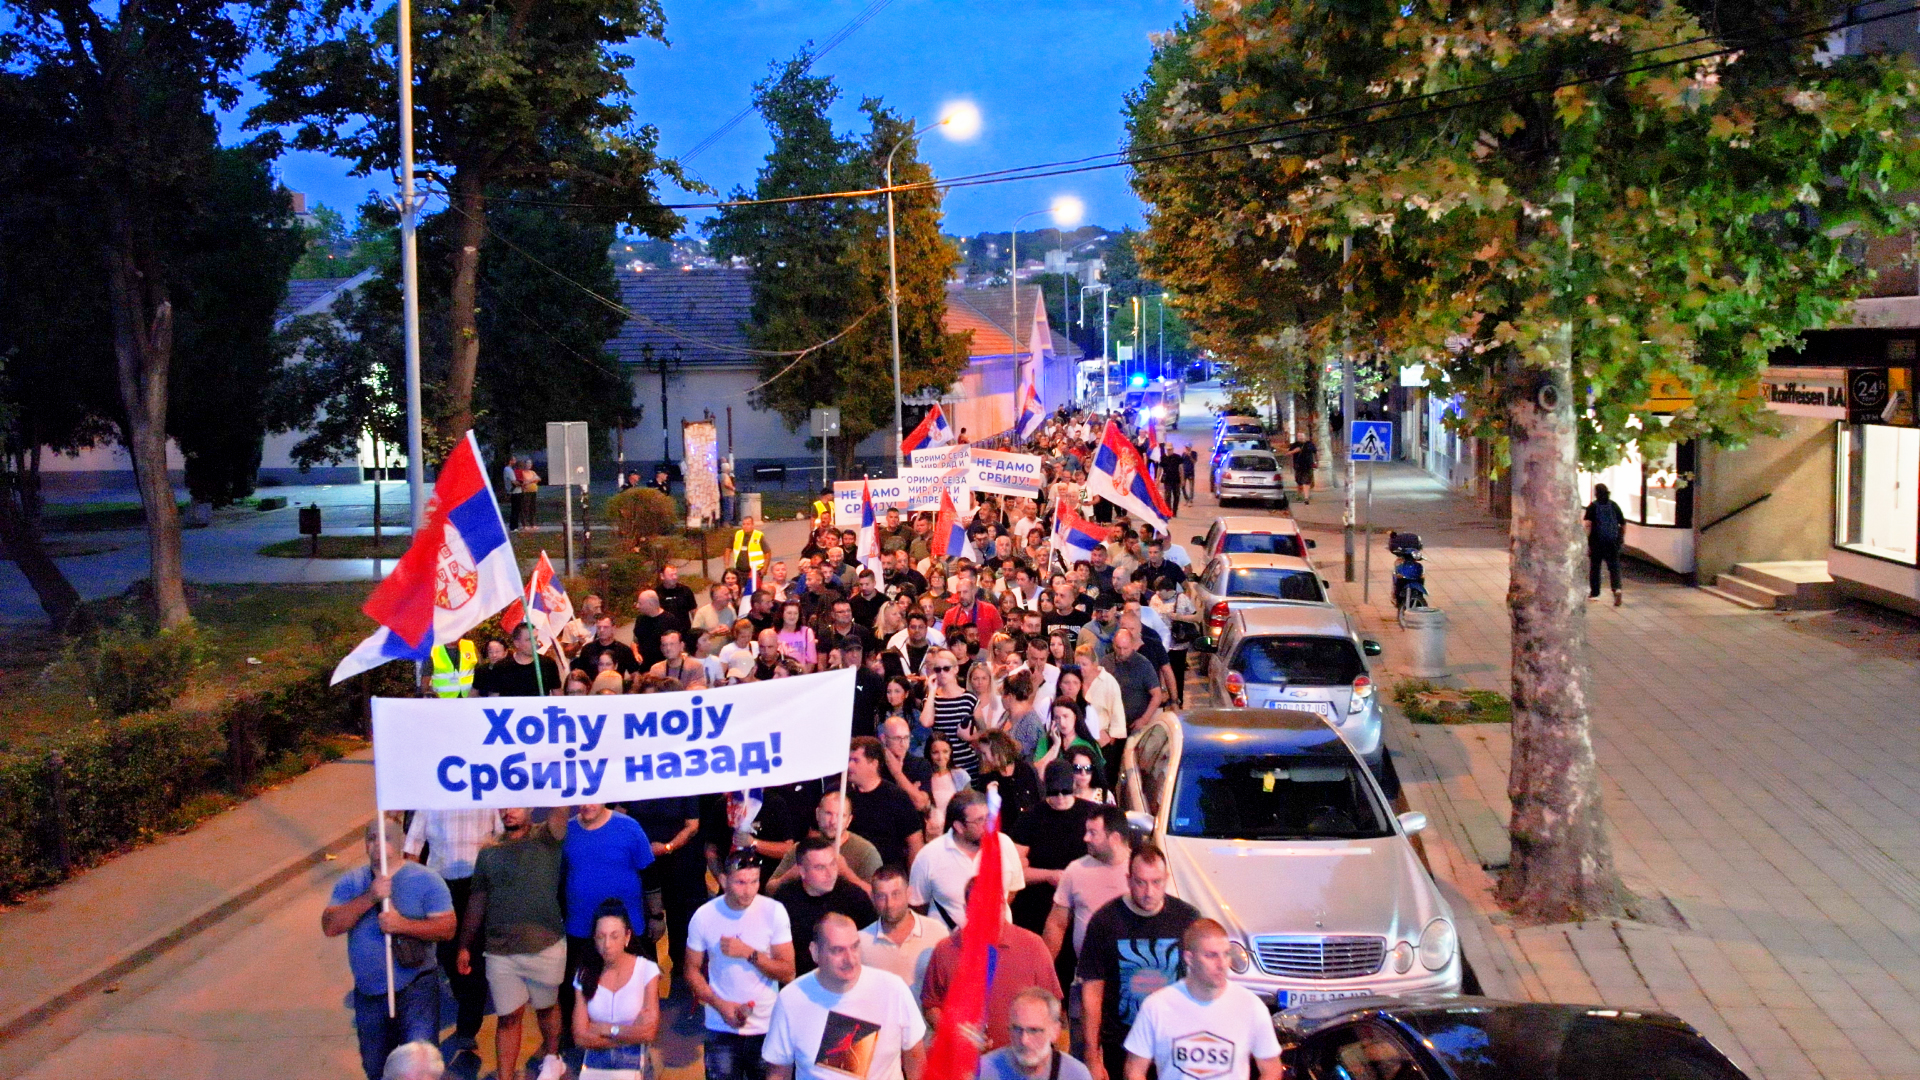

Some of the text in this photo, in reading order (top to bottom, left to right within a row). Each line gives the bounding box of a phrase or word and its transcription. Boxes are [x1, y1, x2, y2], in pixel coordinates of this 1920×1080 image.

[1771, 382, 1846, 407] Raiffeisen BA
[914, 451, 970, 464] БОРИМО СЕ ЗА
[976, 457, 1034, 474] НЕ ДАМО
[901, 475, 967, 484] ОРИМО СЕ ЗА
[978, 471, 1030, 487] СРБИЈУ!
[841, 487, 900, 501] НЕ АМО
[953, 486, 960, 494] И
[909, 495, 959, 504] НАПРЕК
[844, 501, 897, 514] СРИЈУ!
[482, 695, 734, 752] Хоћу моју
[437, 731, 783, 801] Србију назад!
[1177, 1046, 1229, 1065] BOSS
